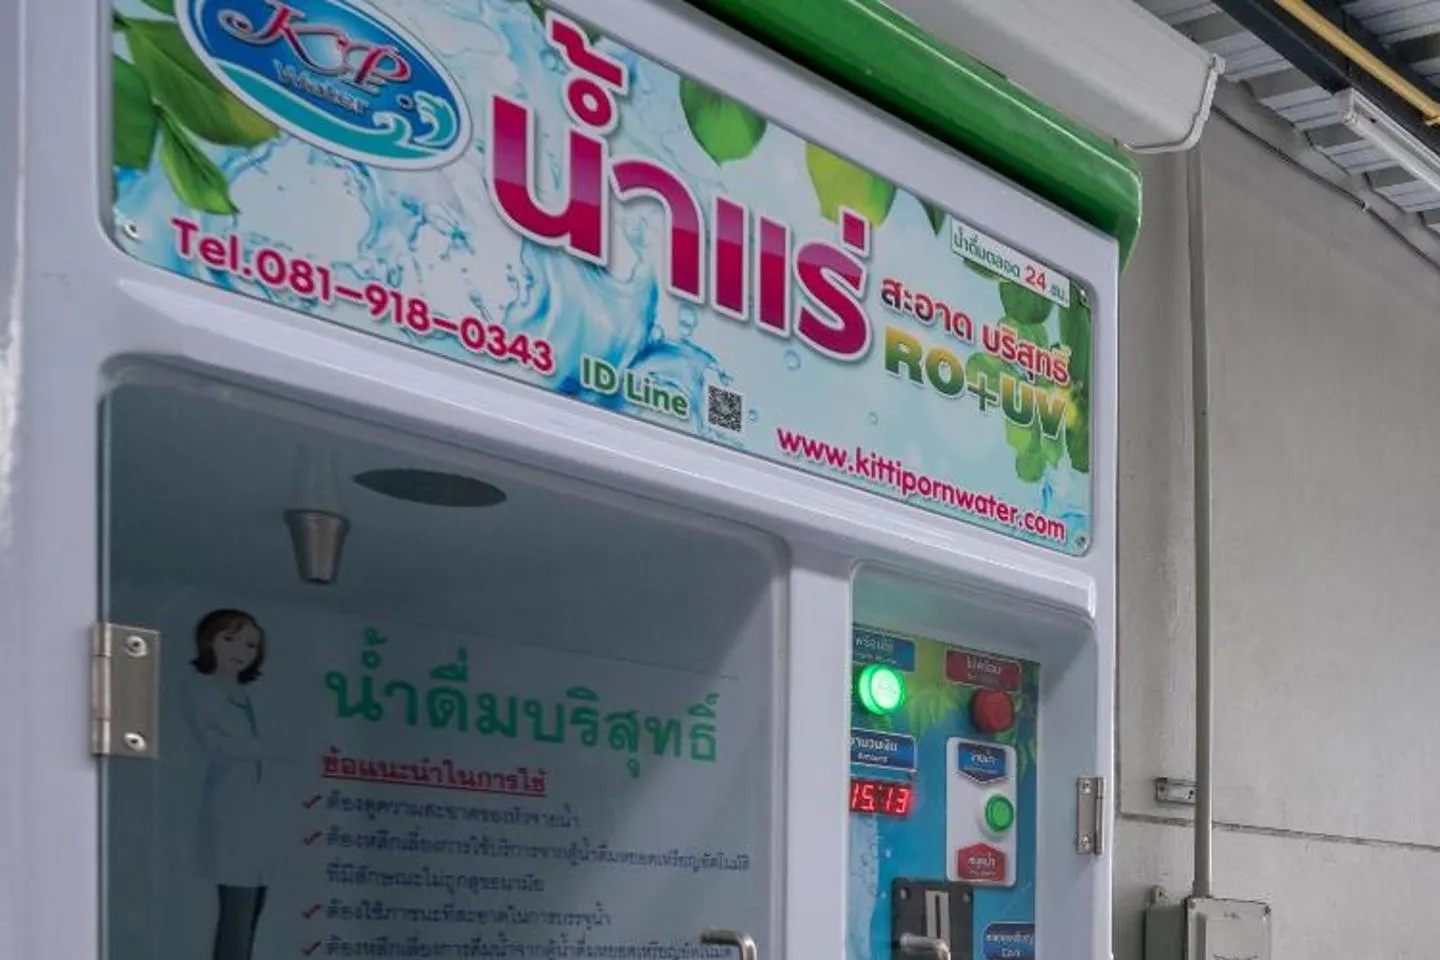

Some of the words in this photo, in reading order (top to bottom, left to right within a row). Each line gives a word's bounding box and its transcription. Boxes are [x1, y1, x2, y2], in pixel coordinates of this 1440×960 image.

[491, 16, 868, 357] น้ำแร่
[880, 277, 972, 341] สะอาด
[981, 322, 1071, 386] บริสุทธิ์
[1025, 264, 1047, 291] 24
[582, 357, 616, 394] ID
[626, 373, 689, 418] Line
[777, 427, 1067, 541] www.kittipornwater.com
[324, 627, 721, 778] น้ำดื่มบริสุทธิ์
[322, 745, 549, 794] ข้อแนะนำในการใช้
